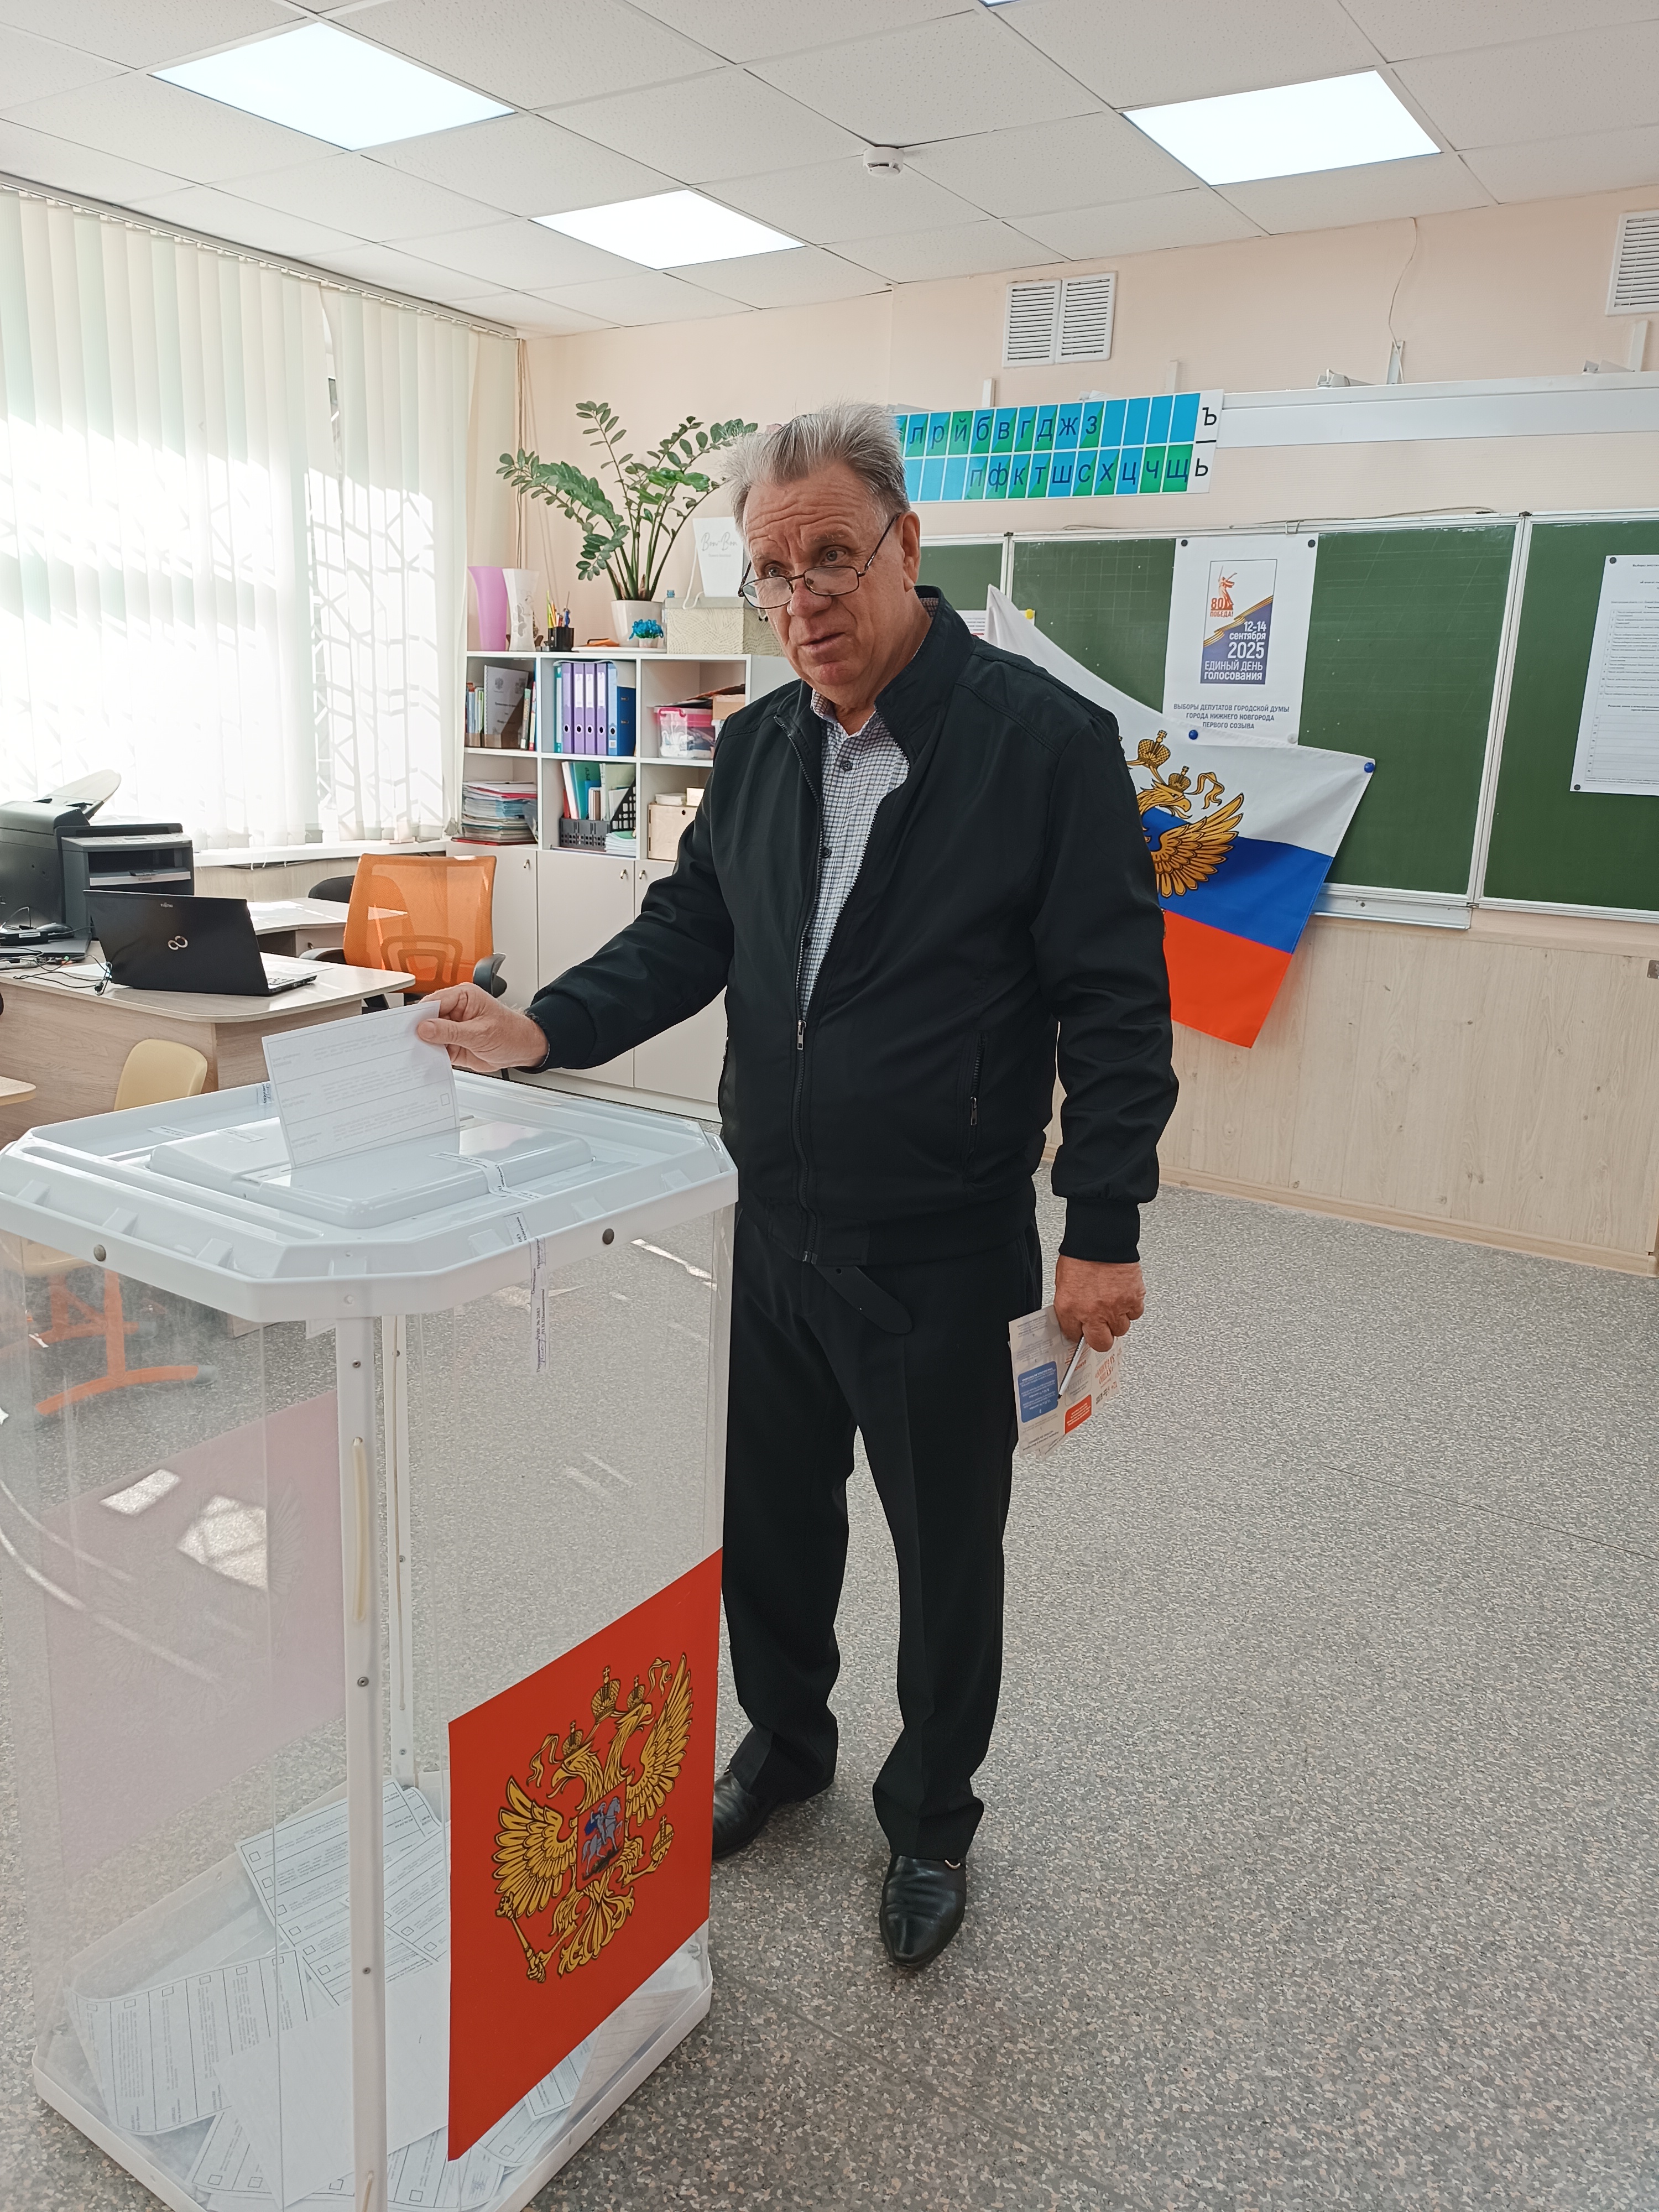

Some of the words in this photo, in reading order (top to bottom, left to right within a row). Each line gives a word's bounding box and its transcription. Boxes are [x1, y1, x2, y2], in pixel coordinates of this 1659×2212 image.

[1211, 598, 1224, 609] 80
[1244, 621, 1266, 632] 12-14
[1229, 631, 1266, 641] сентября
[1228, 641, 1265, 659] 2025
[1204, 659, 1239, 671] ЕДИНЫЙ
[1240, 661, 1263, 671] ДЕНЬ
